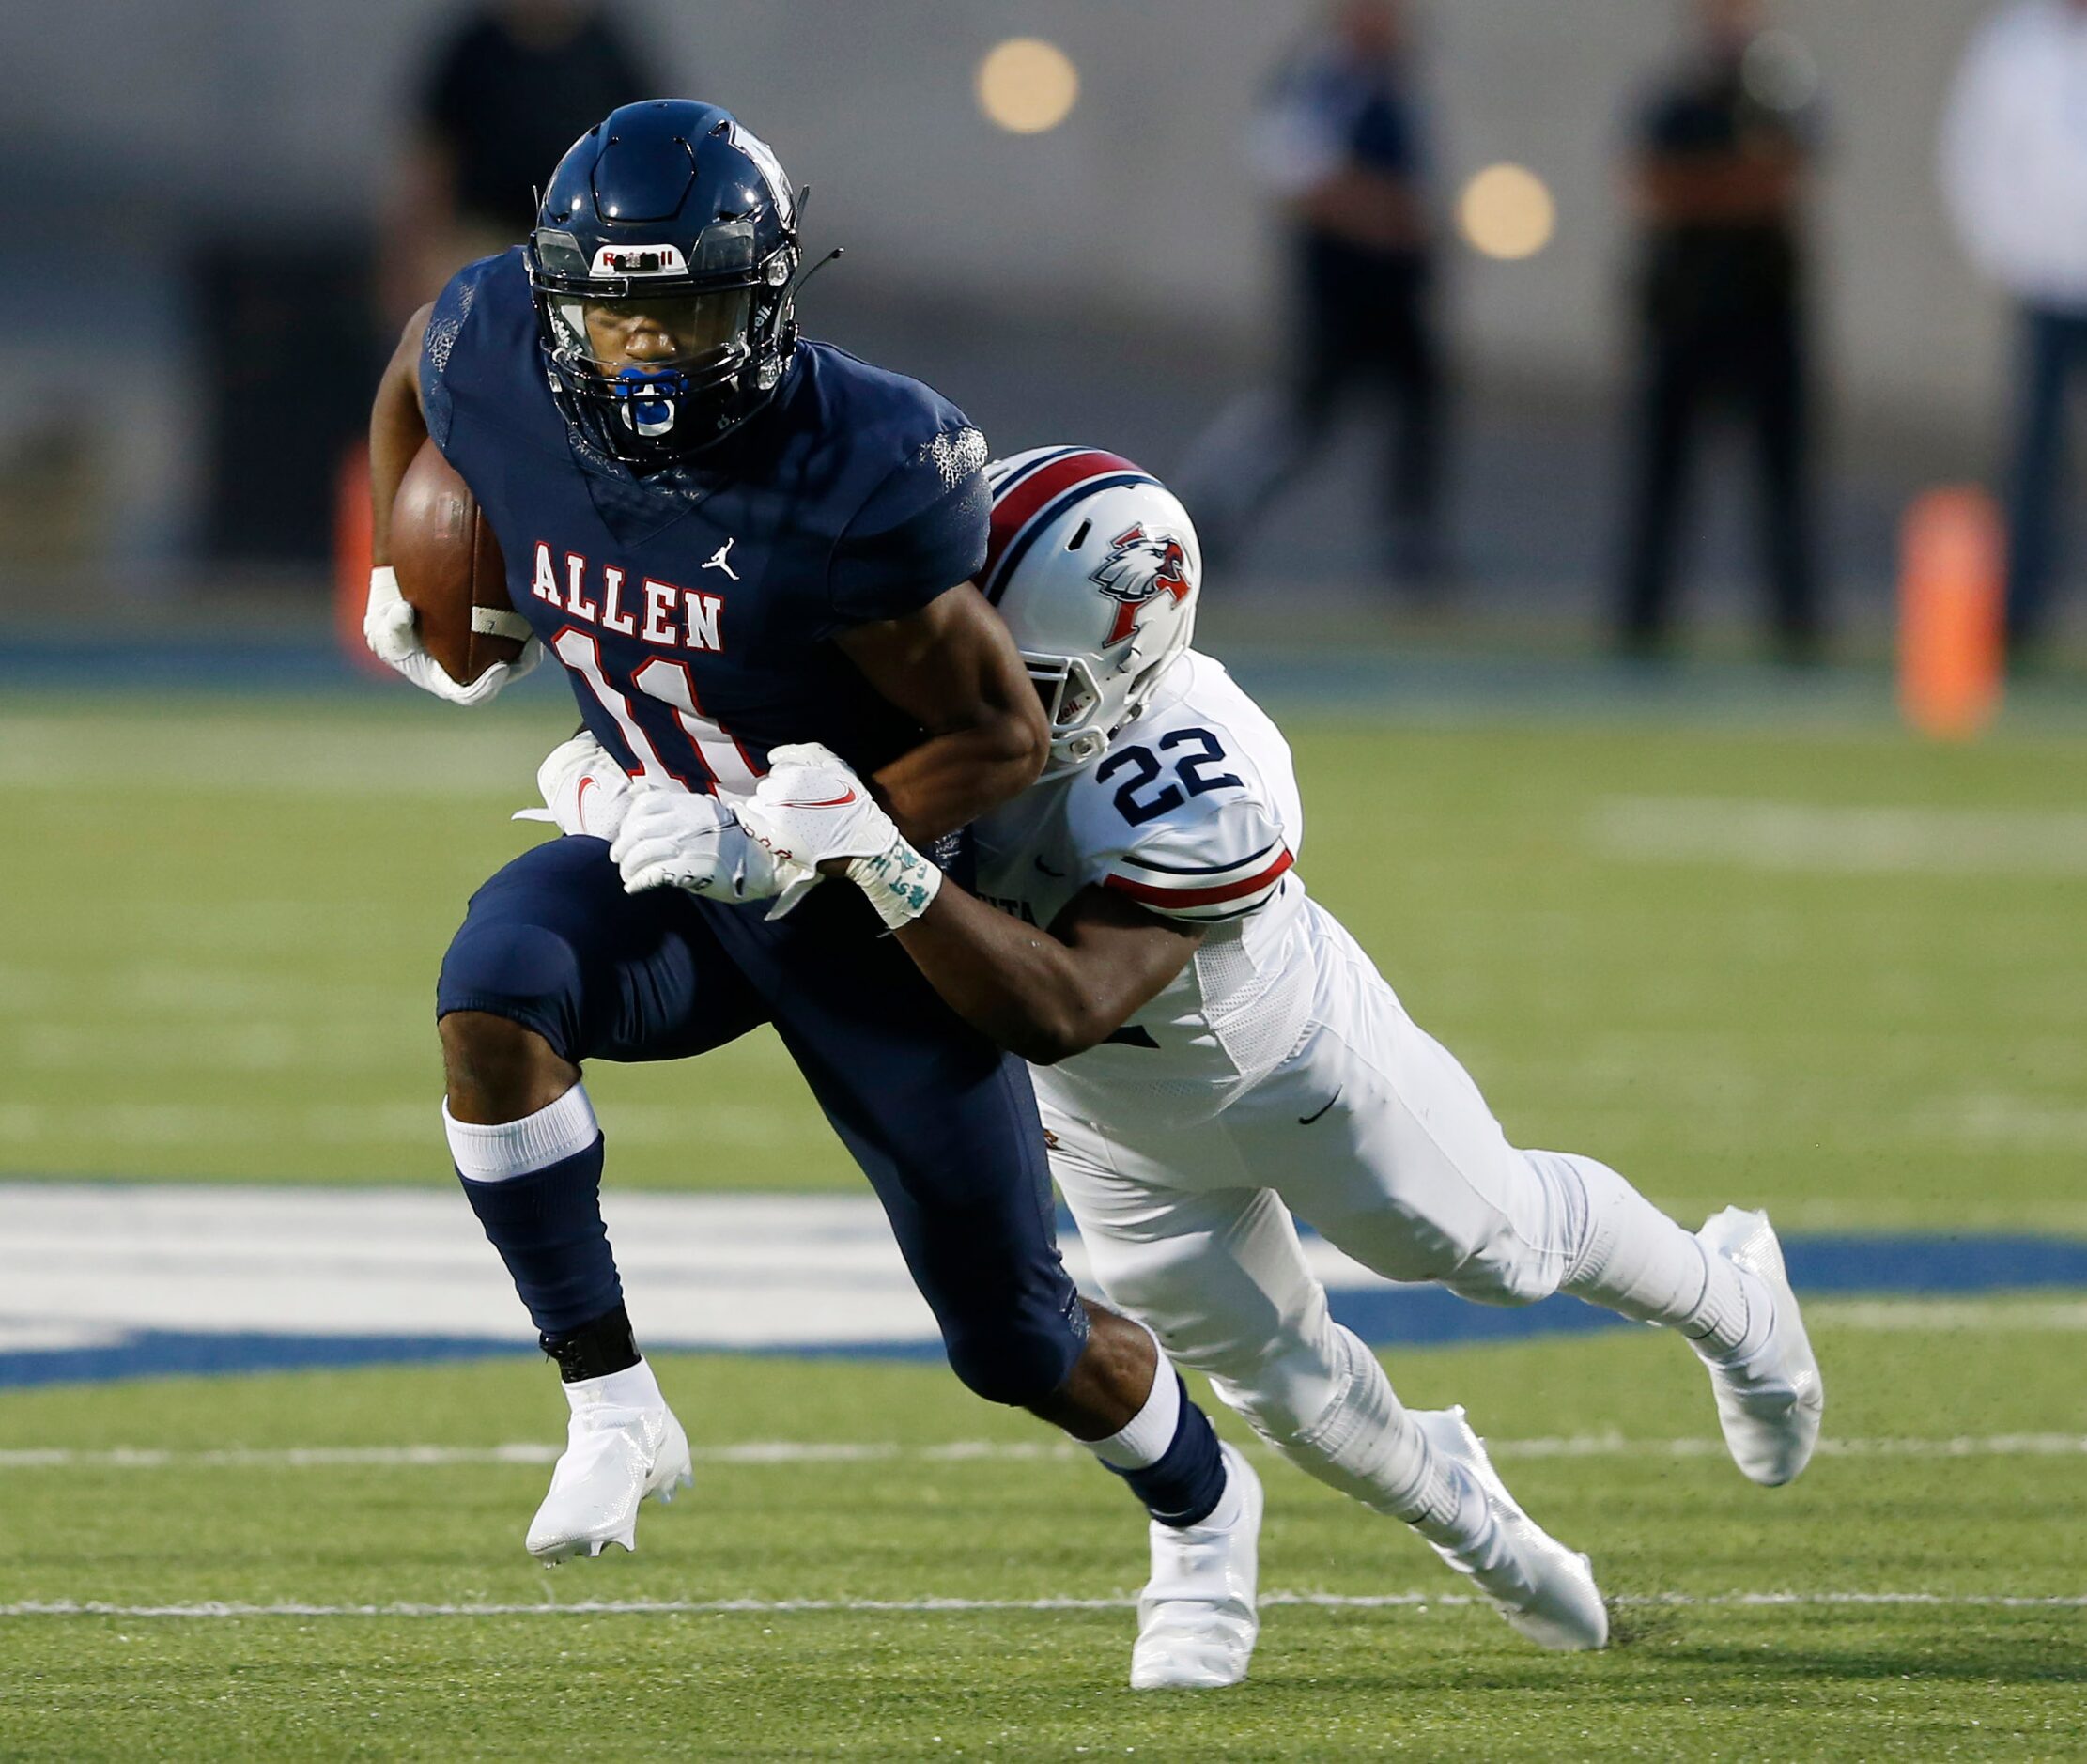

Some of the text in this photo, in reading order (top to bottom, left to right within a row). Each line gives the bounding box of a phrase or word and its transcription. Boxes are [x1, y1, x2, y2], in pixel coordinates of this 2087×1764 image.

[533, 540, 724, 653] ALLEN
[551, 625, 768, 802] 11
[1096, 728, 1245, 827] 22
